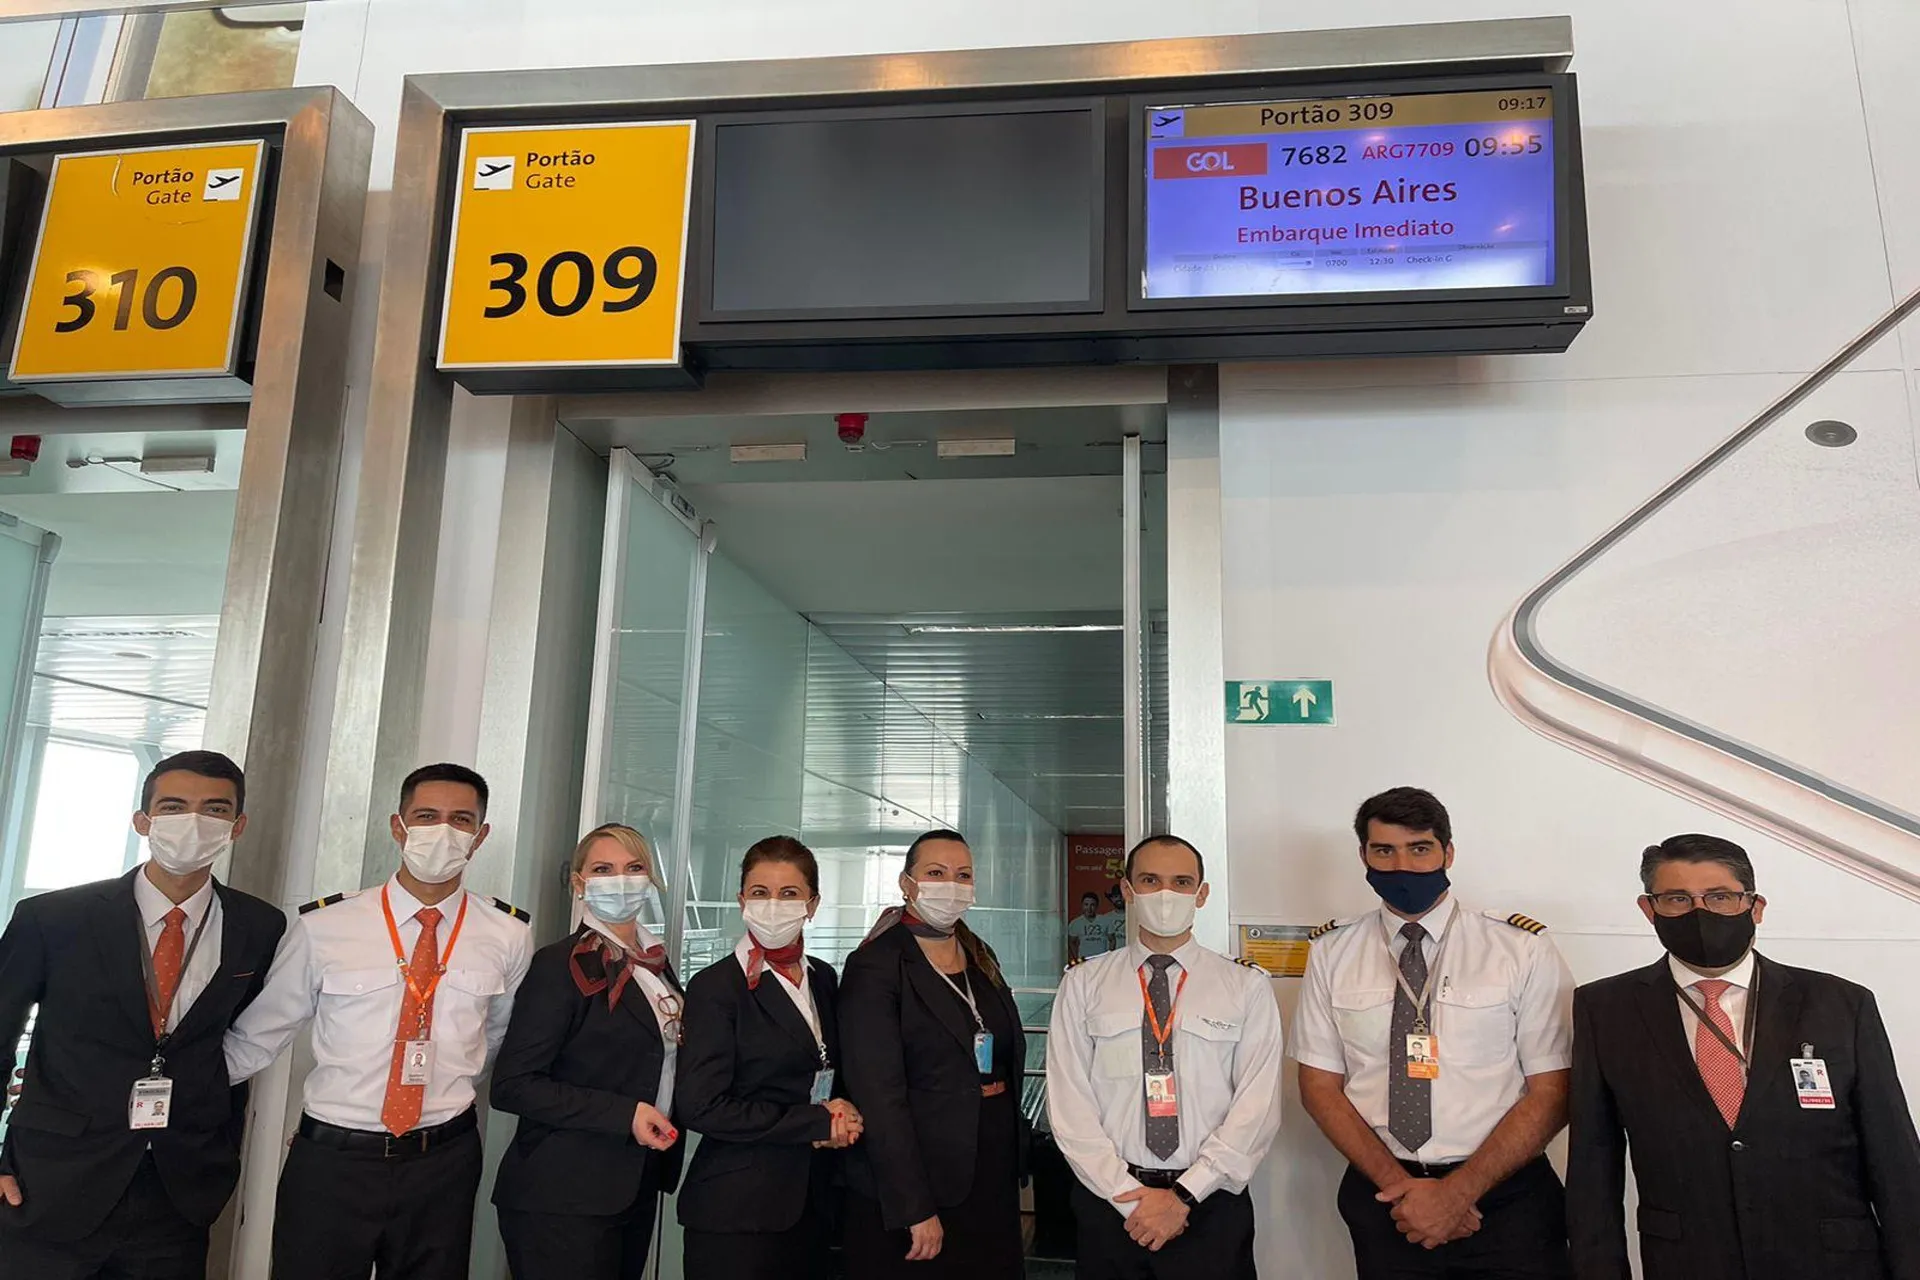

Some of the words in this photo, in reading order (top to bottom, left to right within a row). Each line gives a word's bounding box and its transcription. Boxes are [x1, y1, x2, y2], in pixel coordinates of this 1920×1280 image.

[1260, 104, 1340, 126] Portão
[1349, 102, 1394, 122] 309
[1498, 96, 1546, 111] 09:17
[526, 150, 595, 167] Portão
[1282, 145, 1347, 166] 7682
[1362, 141, 1454, 160] ARG7709
[1464, 135, 1542, 157] 09:55
[1186, 151, 1235, 172] GOL
[132, 168, 194, 186] Portão
[526, 173, 576, 189] Gate
[146, 189, 192, 206] Gate
[1239, 185, 1361, 210] Buenos
[1372, 177, 1457, 204] Aires
[1237, 225, 1348, 245] Embarque
[1355, 219, 1454, 239] Imediato
[1369, 257, 1394, 265] 12:30
[483, 245, 658, 319] 309
[54, 266, 198, 333] 310
